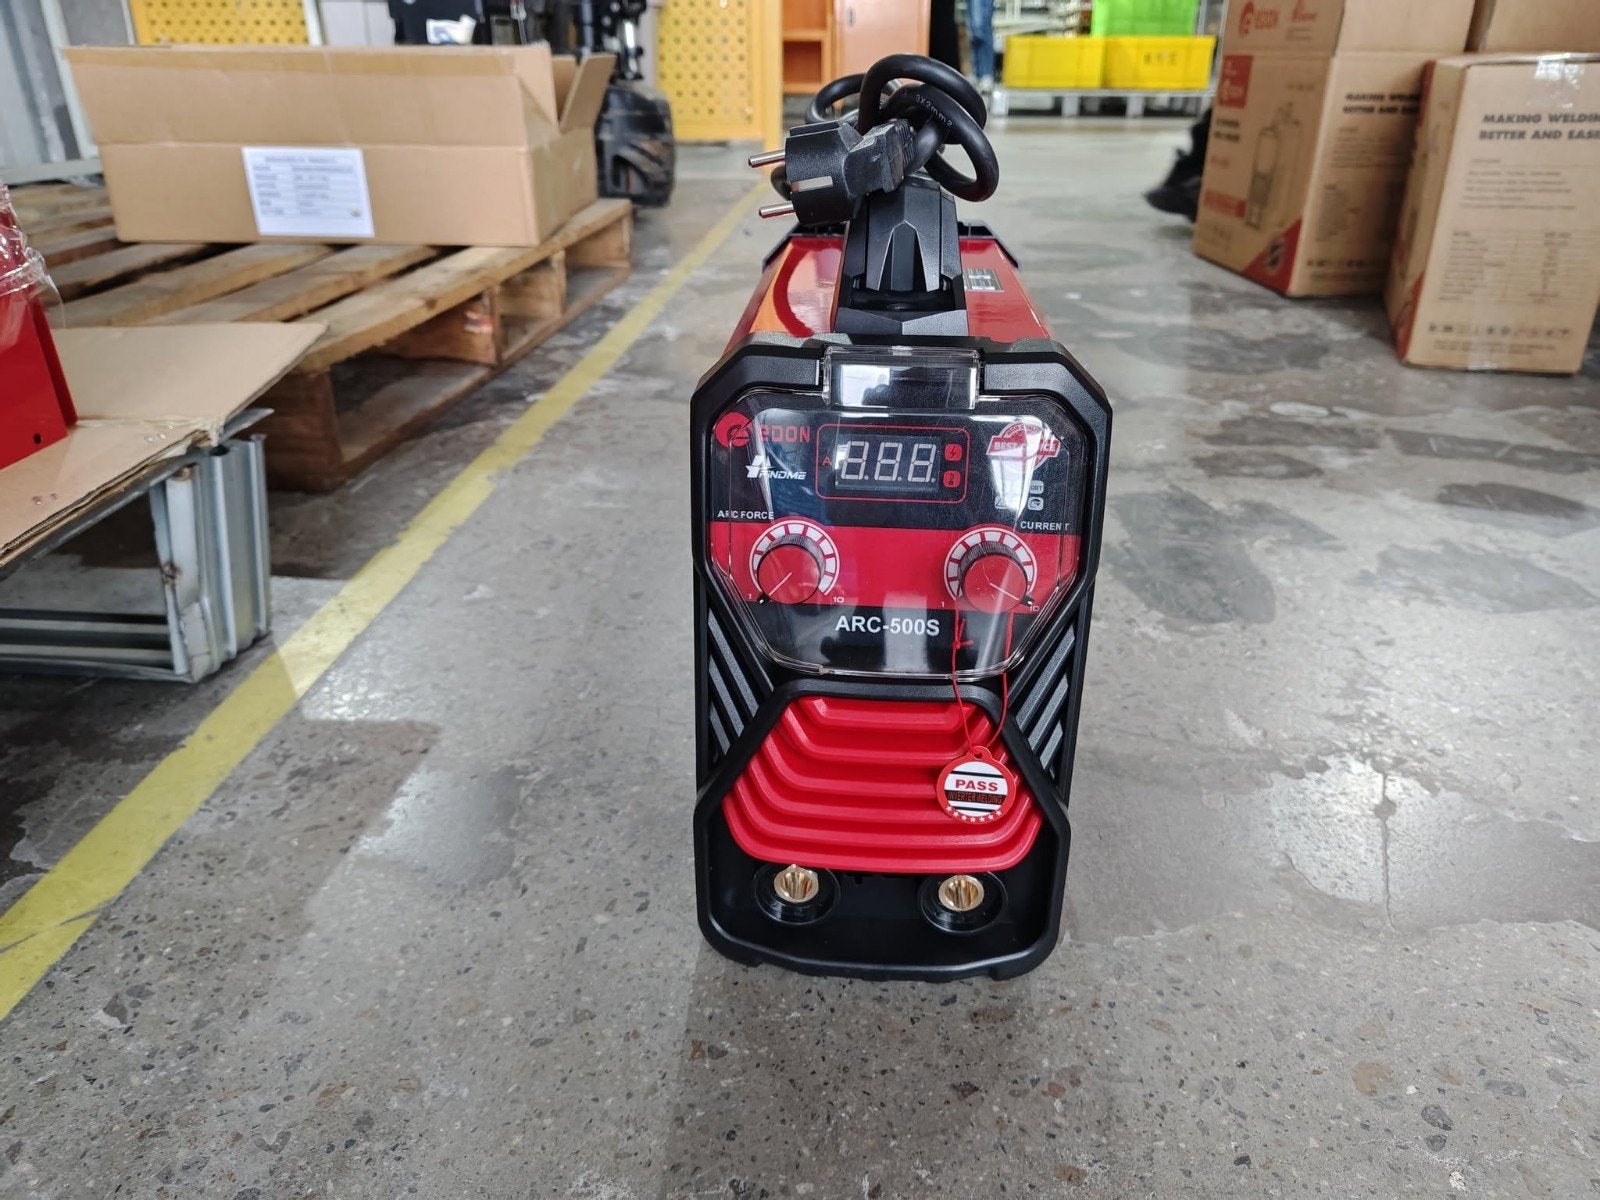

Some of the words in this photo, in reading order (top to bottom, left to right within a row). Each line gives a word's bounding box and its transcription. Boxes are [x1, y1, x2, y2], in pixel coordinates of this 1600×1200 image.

[1482, 113, 1542, 123] MAKING
[1479, 130, 1526, 140] BETTER
[1531, 130, 1562, 140] AND
[741, 510, 775, 520] FORCE
[1020, 521, 1070, 531] CURRENT
[832, 596, 845, 604] 10
[834, 615, 940, 637] ARC-500S
[955, 779, 999, 792] PASS
